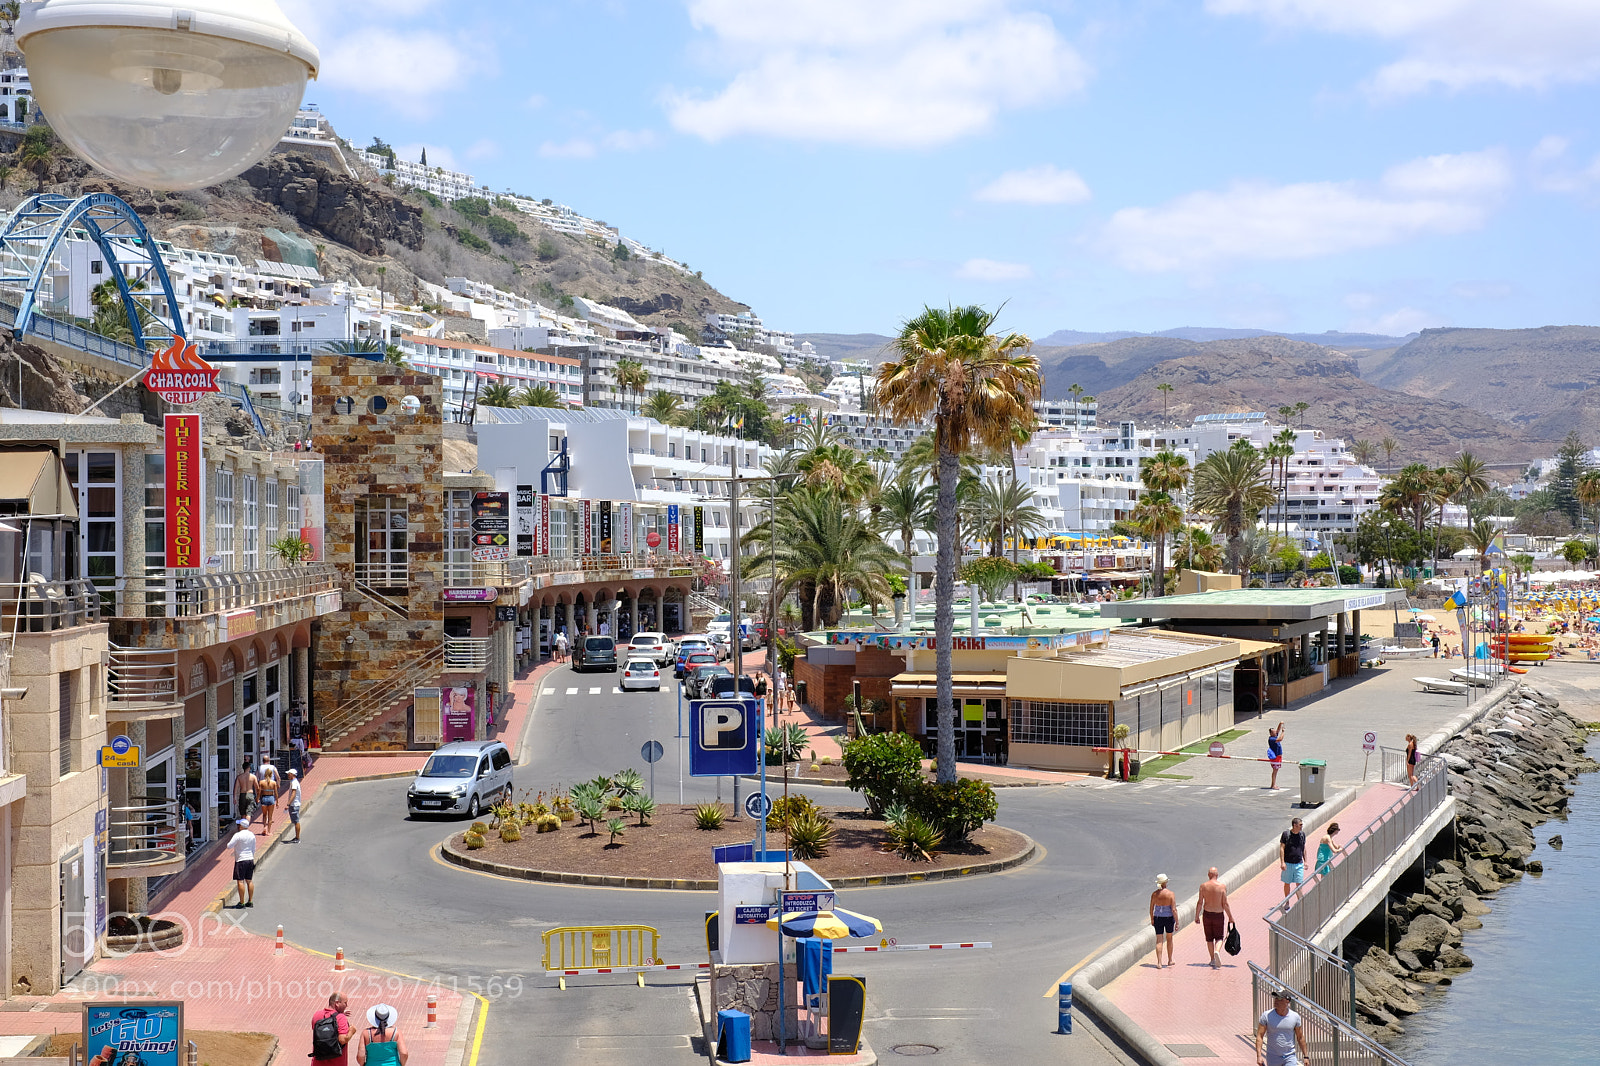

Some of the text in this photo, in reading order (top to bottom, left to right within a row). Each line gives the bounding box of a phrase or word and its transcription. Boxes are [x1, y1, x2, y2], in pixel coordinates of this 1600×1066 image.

[149, 373, 213, 389] CHARCOAL
[165, 392, 199, 404] GRILL
[174, 417, 193, 566] THE BEER HARBOUR
[670, 524, 678, 551] SPORTS
[704, 708, 743, 746] P
[90, 1018, 121, 1037] Let's
[110, 1015, 163, 1046] GO
[117, 1039, 178, 1055] Diving!
